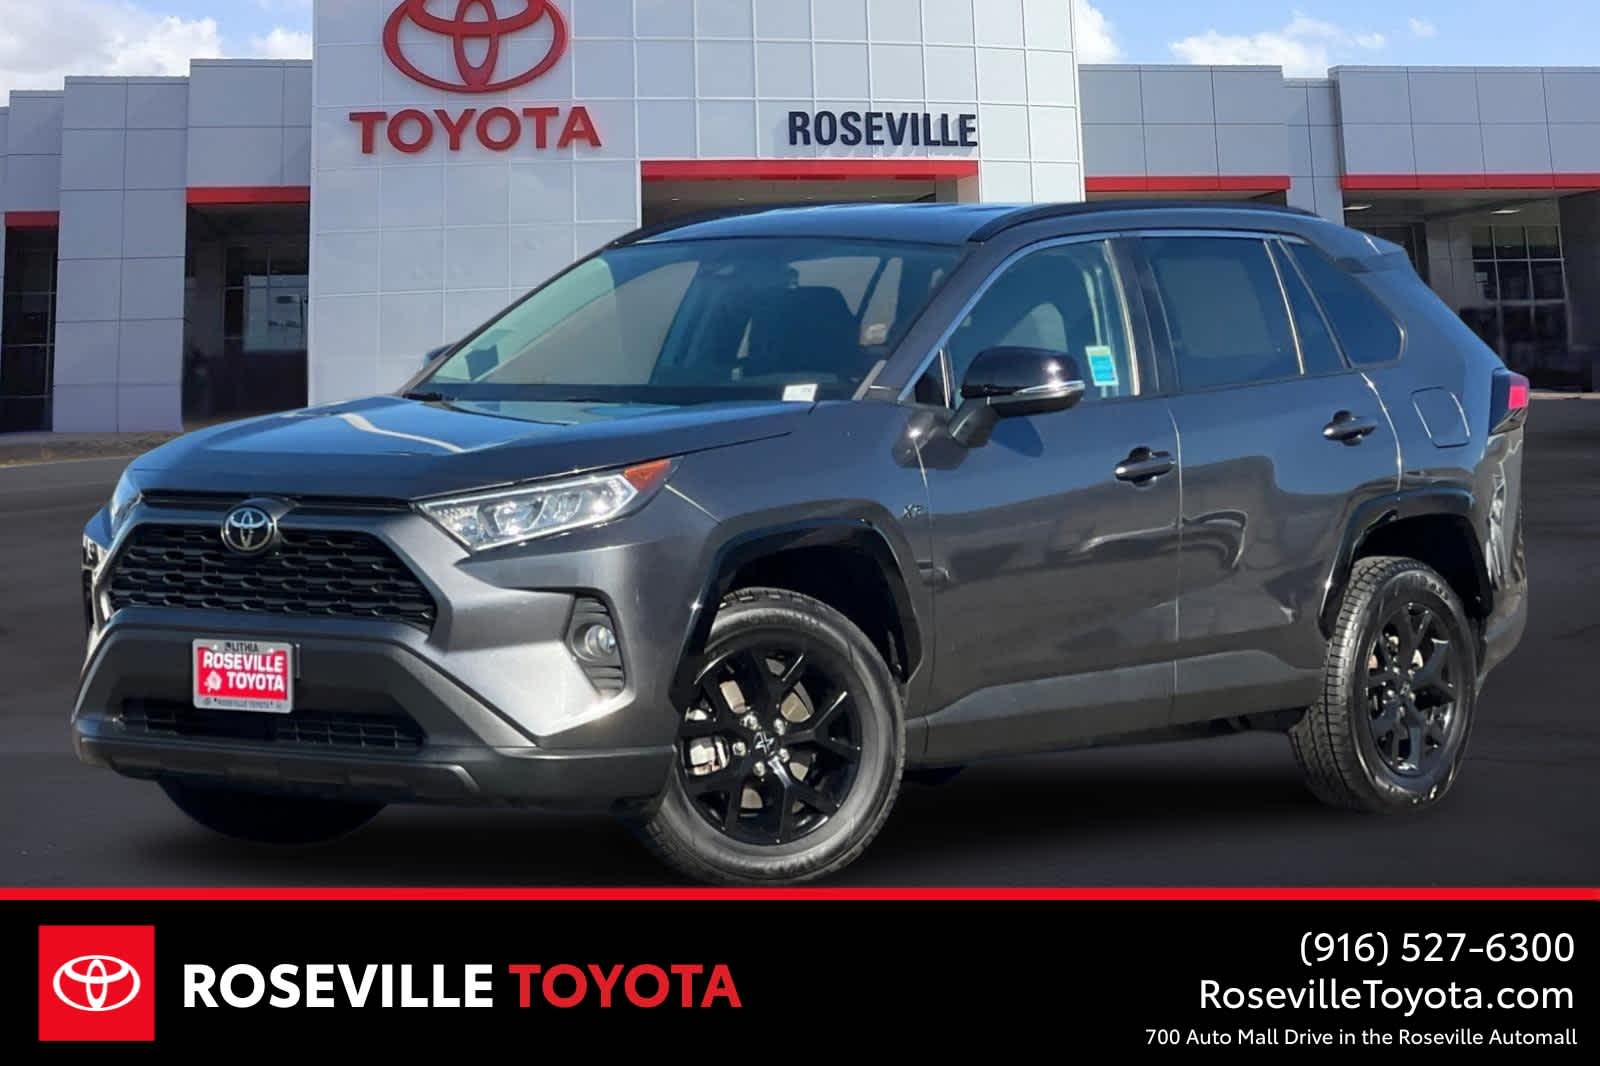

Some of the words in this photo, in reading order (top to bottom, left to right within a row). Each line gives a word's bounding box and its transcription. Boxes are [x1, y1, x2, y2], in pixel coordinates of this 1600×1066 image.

[349, 106, 602, 154] TOYOTA
[788, 110, 978, 147] ROSEVILLE
[203, 651, 284, 673] ROSEVILLE
[226, 671, 285, 692] TOYOTA
